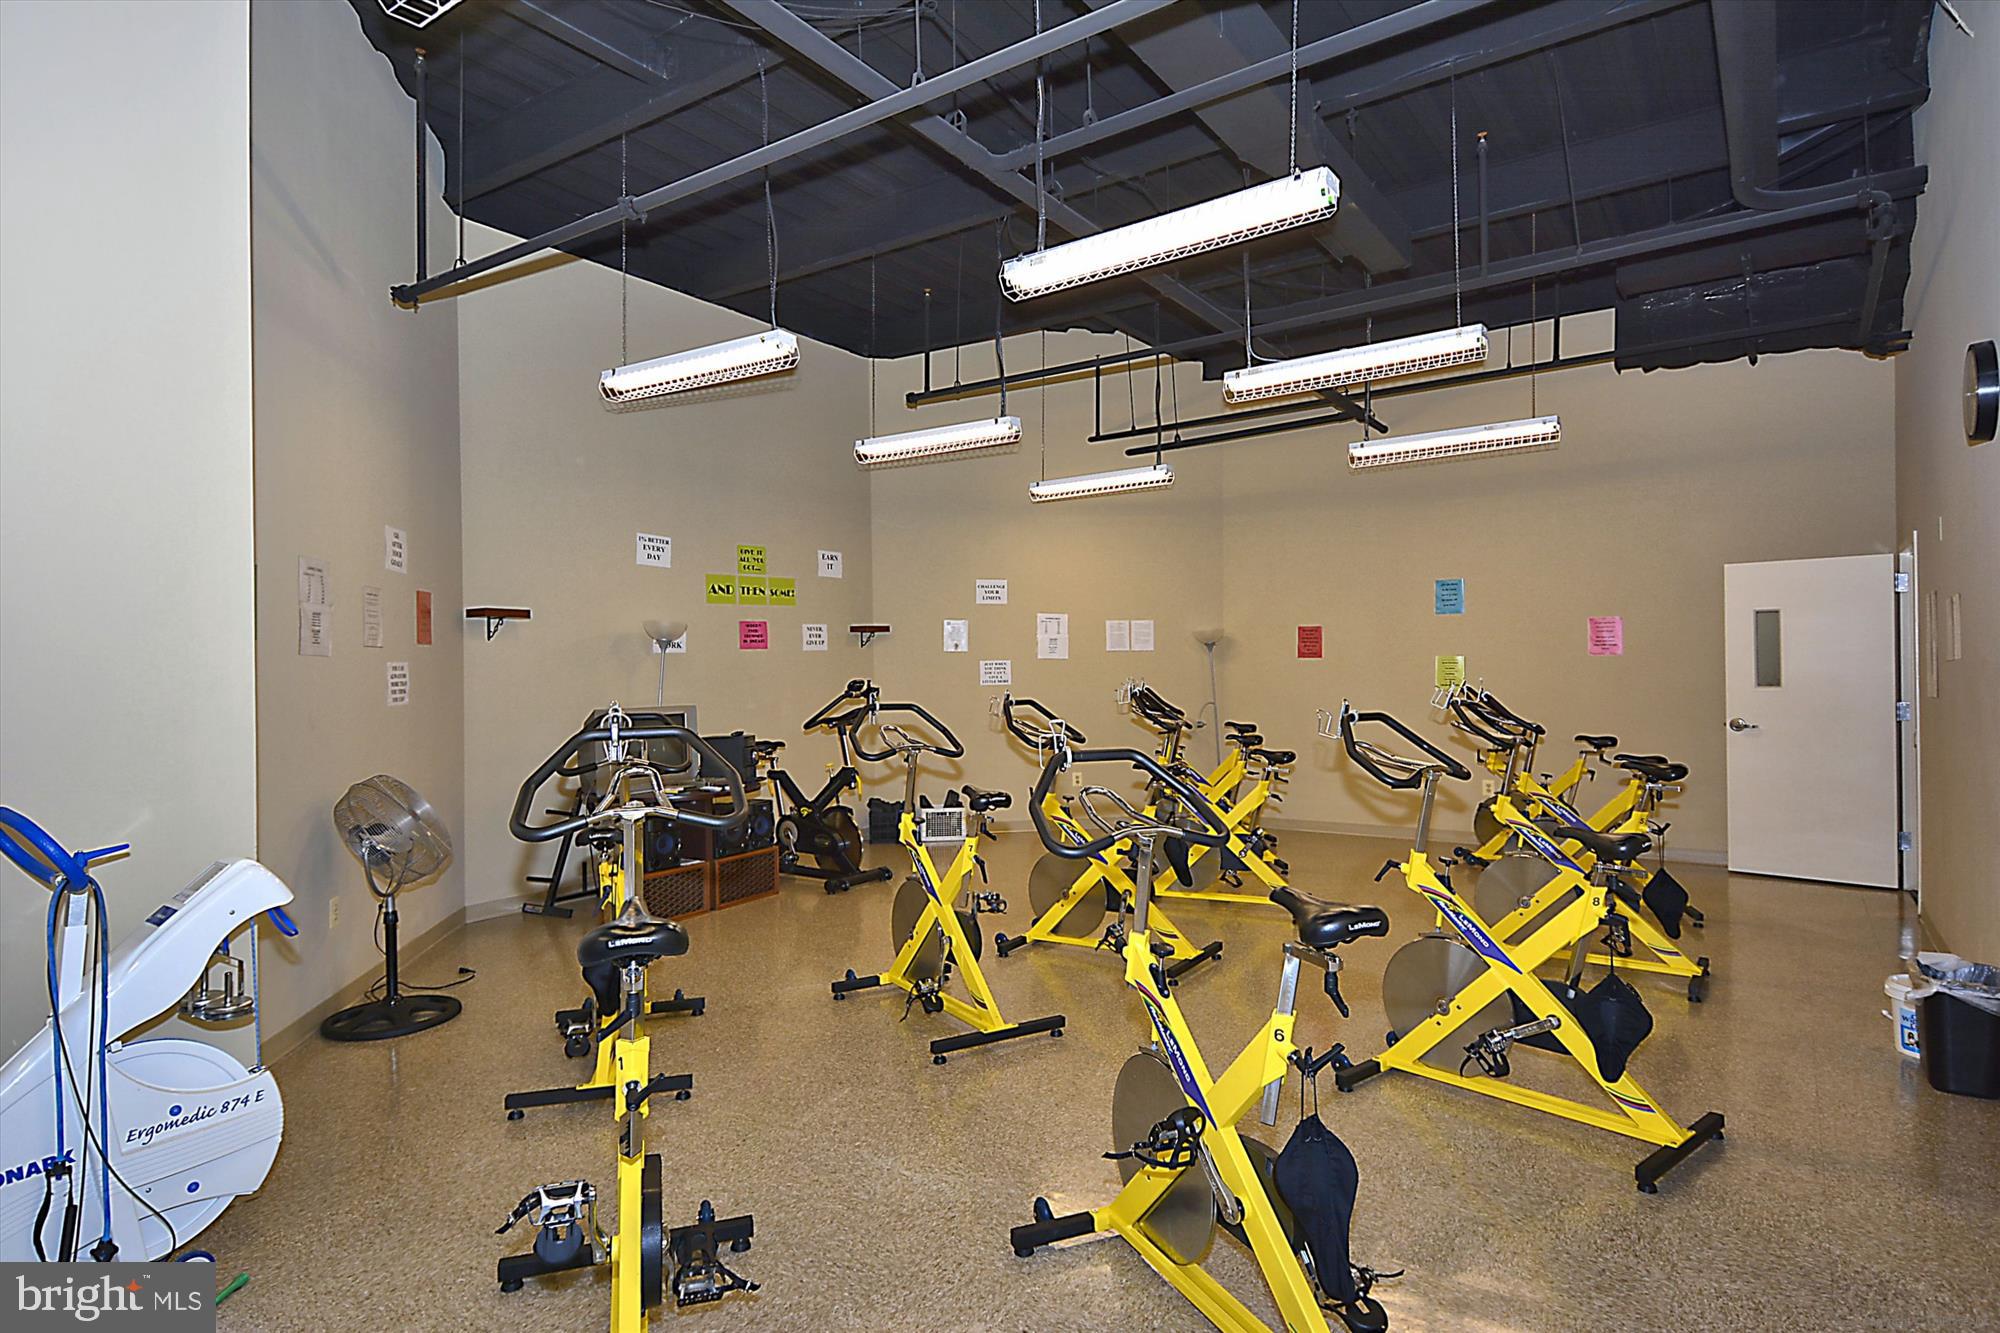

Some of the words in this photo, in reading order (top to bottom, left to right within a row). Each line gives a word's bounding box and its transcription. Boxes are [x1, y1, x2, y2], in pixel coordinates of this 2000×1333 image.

[648, 537, 670, 545] BETTER
[642, 543, 666, 553] EVERY
[646, 553, 661, 561] DAY
[821, 553, 839, 561] EARN
[708, 583, 735, 595] AND
[740, 586, 766, 596] THEN
[769, 588, 795, 598] SOME!
[968, 844, 974, 852] 7
[1592, 896, 1600, 907] 8
[1274, 1028, 1285, 1042] 6
[618, 1056, 624, 1071] 1
[126, 1105, 217, 1145] Ergomedic
[219, 1094, 252, 1114] 874
[254, 1089, 265, 1103] E
